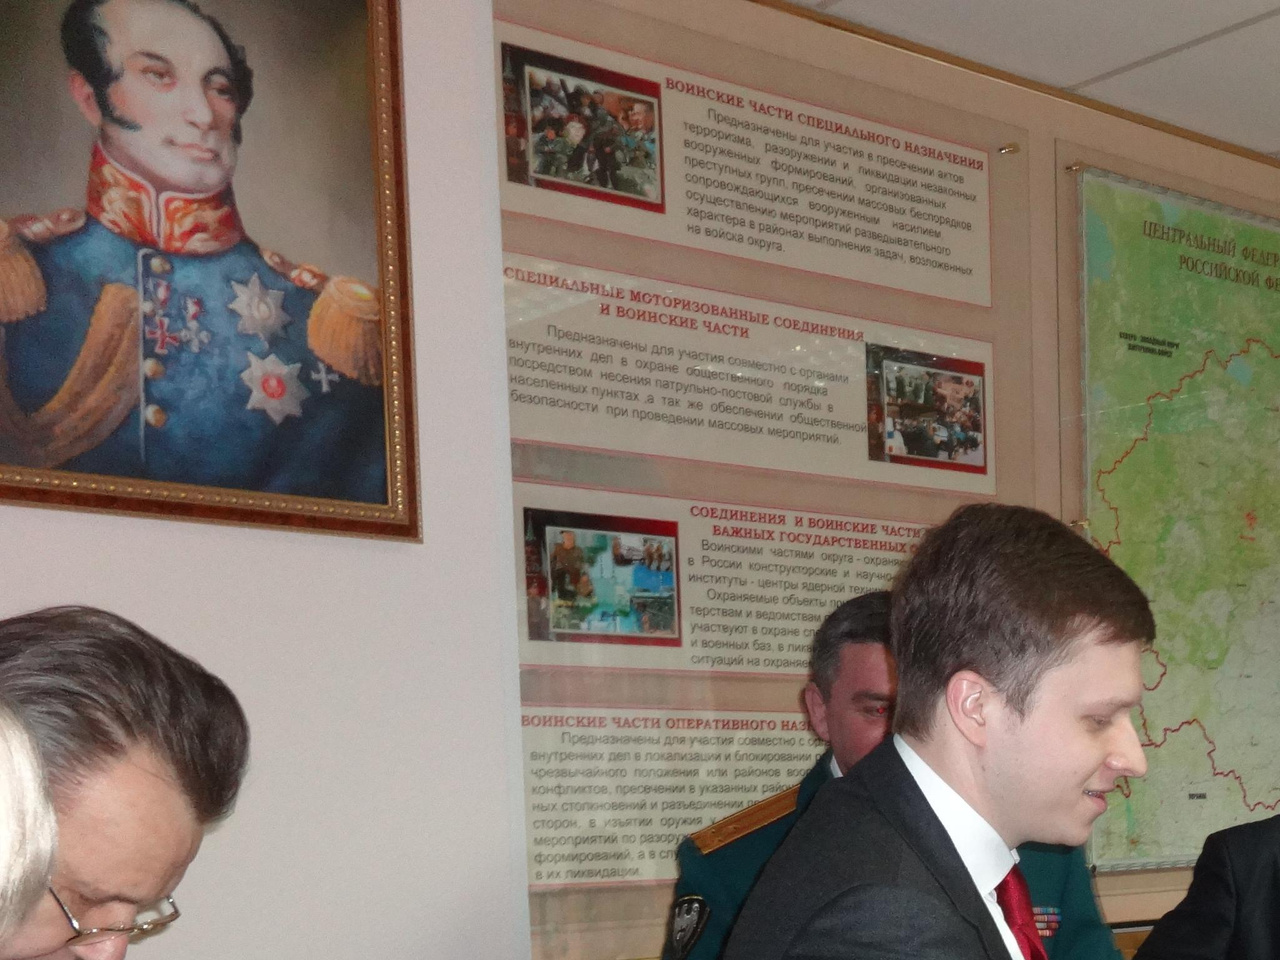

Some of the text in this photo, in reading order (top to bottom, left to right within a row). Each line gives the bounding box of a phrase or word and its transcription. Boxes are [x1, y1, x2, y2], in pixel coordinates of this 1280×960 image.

[666, 77, 984, 171] ВОИНСКИЕ ЧАСТИ СПЕЦИАЛЬНОГО НАЗНАЧЕНИЯ
[684, 139, 760, 165] вооруженных
[708, 108, 964, 183] Предназначены для участия в пресечении актов
[765, 142, 837, 168] разоружении
[859, 166, 917, 187] ликвидации
[921, 182, 977, 201] незаконных
[685, 156, 752, 180] преступных
[792, 181, 855, 203] пресечении
[859, 199, 906, 215] массовых
[685, 173, 798, 205] сопровождающихся
[808, 201, 881, 224] вооруженным
[686, 190, 951, 255] осуществлению мероприятий разведывательного
[687, 224, 785, 252] на войска округа.
[687, 207, 745, 227] характера
[750, 220, 755, 229] в
[759, 224, 804, 240] районах
[808, 233, 871, 254] выполнения
[910, 255, 973, 275] возложенных
[1143, 220, 1237, 257] ЦЕНТРАЛЬНЫЙ
[1179, 255, 1260, 287] РОССИЙСКОЙ
[503, 267, 864, 341] СПЕЦИАЛЬНЫЕ МОТОРИЗОВАННЫЕ СОЕДИНЕНИЯ
[600, 303, 750, 338] И ВОИНСКИЕ ЧАСТИ
[509, 339, 828, 396] внутренних дел в охране общественного порядка
[547, 325, 849, 383] Предназначены для участия совместно с органами
[510, 357, 593, 378] посредством
[601, 370, 651, 385] несения
[655, 378, 773, 404] патрульно-постовой
[779, 397, 822, 411] службы
[510, 375, 867, 433] населенных пунктах так же обеспечении общественной
[511, 390, 842, 445] безопасности при проведении массовых мероприятий.
[690, 506, 786, 525] СОЕДИНЕНИЯ
[795, 516, 803, 527] И
[809, 517, 876, 534] ВОИНСКИЕ
[701, 540, 764, 555] Воинскими
[770, 547, 814, 559] частями
[822, 553, 853, 563] округа
[713, 525, 775, 541] ВАЖНЫХ
[780, 532, 907, 553] ГОСУДАРСТВЕННЫХ
[688, 557, 694, 566] в
[702, 556, 742, 570] России
[749, 562, 837, 577] конструкторские
[688, 574, 747, 587] институты
[758, 579, 799, 591] центры
[801, 581, 845, 595] ядерной
[707, 589, 778, 605] Охраняемые
[783, 595, 826, 607] объекты
[690, 606, 742, 618] терствам
[746, 610, 752, 618] и
[756, 611, 821, 622] ведомствам
[690, 623, 748, 635] участвуют
[762, 627, 800, 637] охране
[691, 638, 698, 647] и
[702, 639, 749, 650] военных
[778, 642, 784, 652] в
[691, 654, 811, 668] ситуаций на охраняе
[521, 715, 607, 727] ВОИНСКИЕ
[612, 717, 661, 728] ЧАСТИ
[665, 718, 777, 731] ОПЕРАТИВНОГО
[561, 732, 660, 745] Предназначены
[664, 735, 685, 746] для
[689, 736, 734, 747] участия
[738, 736, 795, 746] совместно
[530, 751, 604, 763] внутренних
[608, 752, 631, 762] дел
[635, 752, 640, 761] в
[645, 751, 722, 762] локализации
[725, 753, 731, 761] и
[735, 751, 811, 763] блокировании
[530, 766, 627, 779] чрезвычайного
[634, 767, 699, 777] положения
[735, 767, 781, 779] районов
[615, 784, 686, 796] пресечении
[689, 783, 696, 791] в
[700, 782, 757, 796] указанных
[532, 802, 557, 811] ных
[562, 800, 646, 811] столкновений
[651, 802, 658, 810] и
[661, 800, 744, 812] разъединении
[589, 819, 596, 827] в
[660, 817, 703, 829] оружия
[534, 834, 618, 847] мероприятий
[622, 834, 636, 843] по
[637, 850, 645, 859] а
[650, 850, 655, 858] в
[535, 871, 542, 880] в
[547, 870, 561, 879] их
